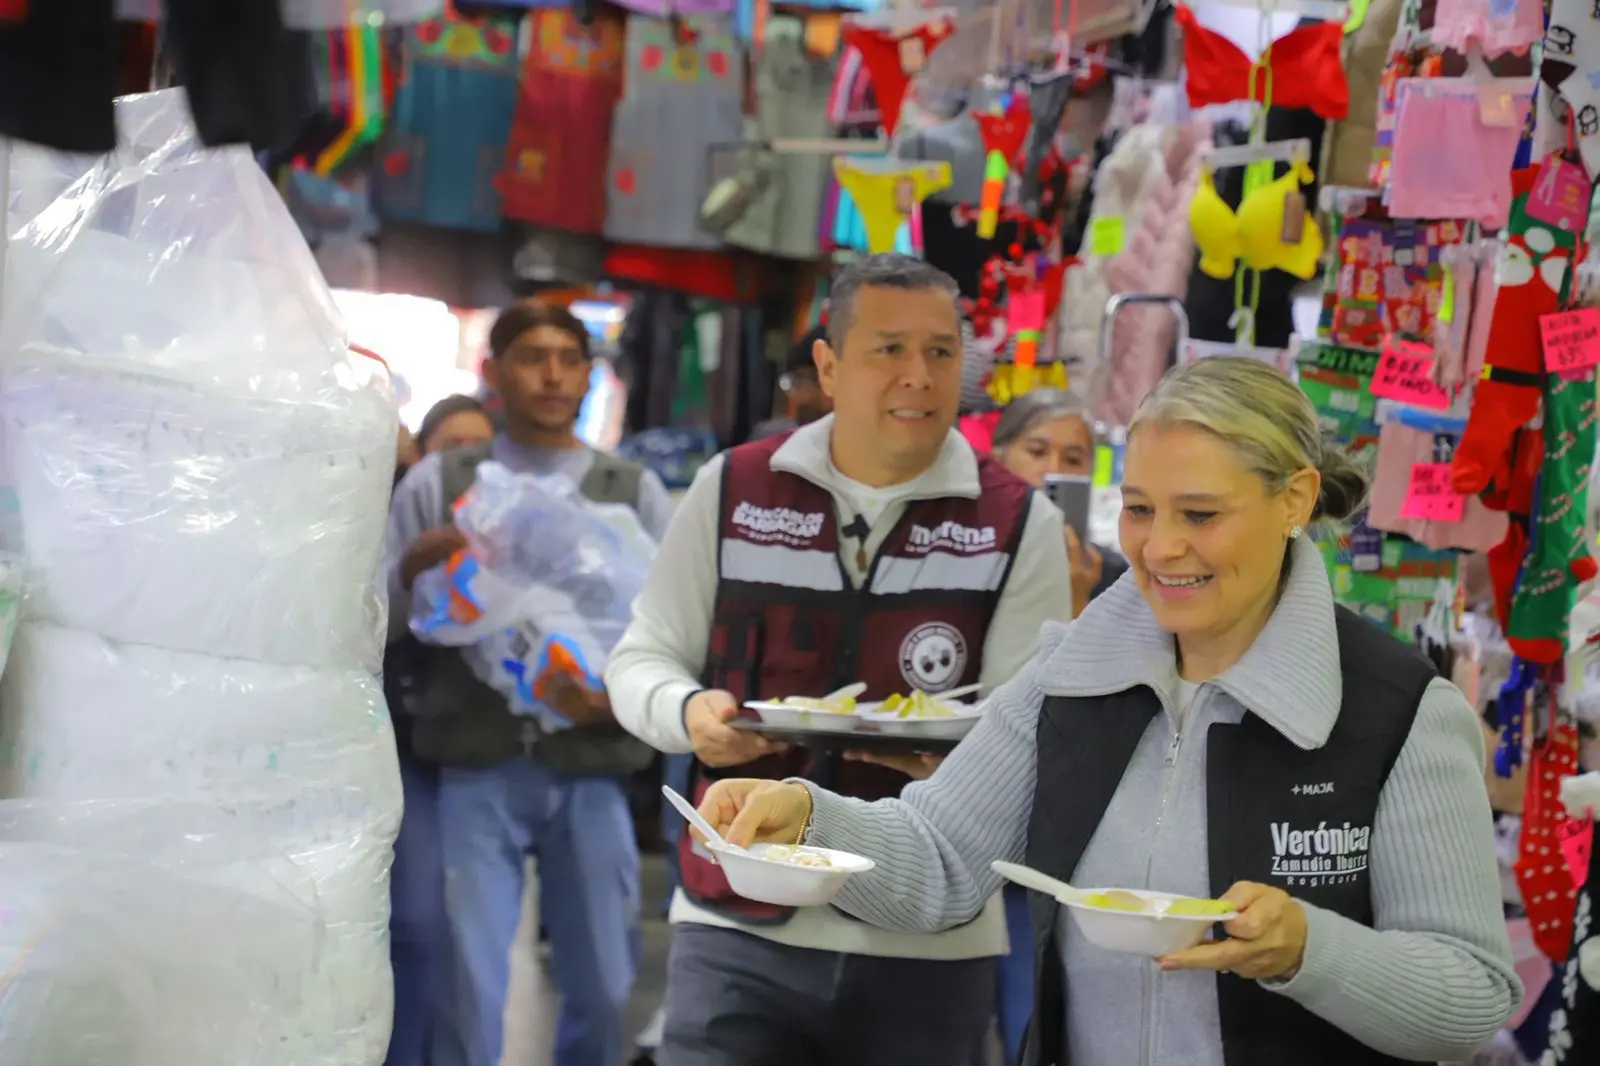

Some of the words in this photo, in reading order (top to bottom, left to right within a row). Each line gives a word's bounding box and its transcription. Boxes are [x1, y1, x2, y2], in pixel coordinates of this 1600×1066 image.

[1270, 821, 1370, 856] Verónica
[1271, 856, 1331, 871] Zamudio
[1286, 873, 1358, 887] Regidora
